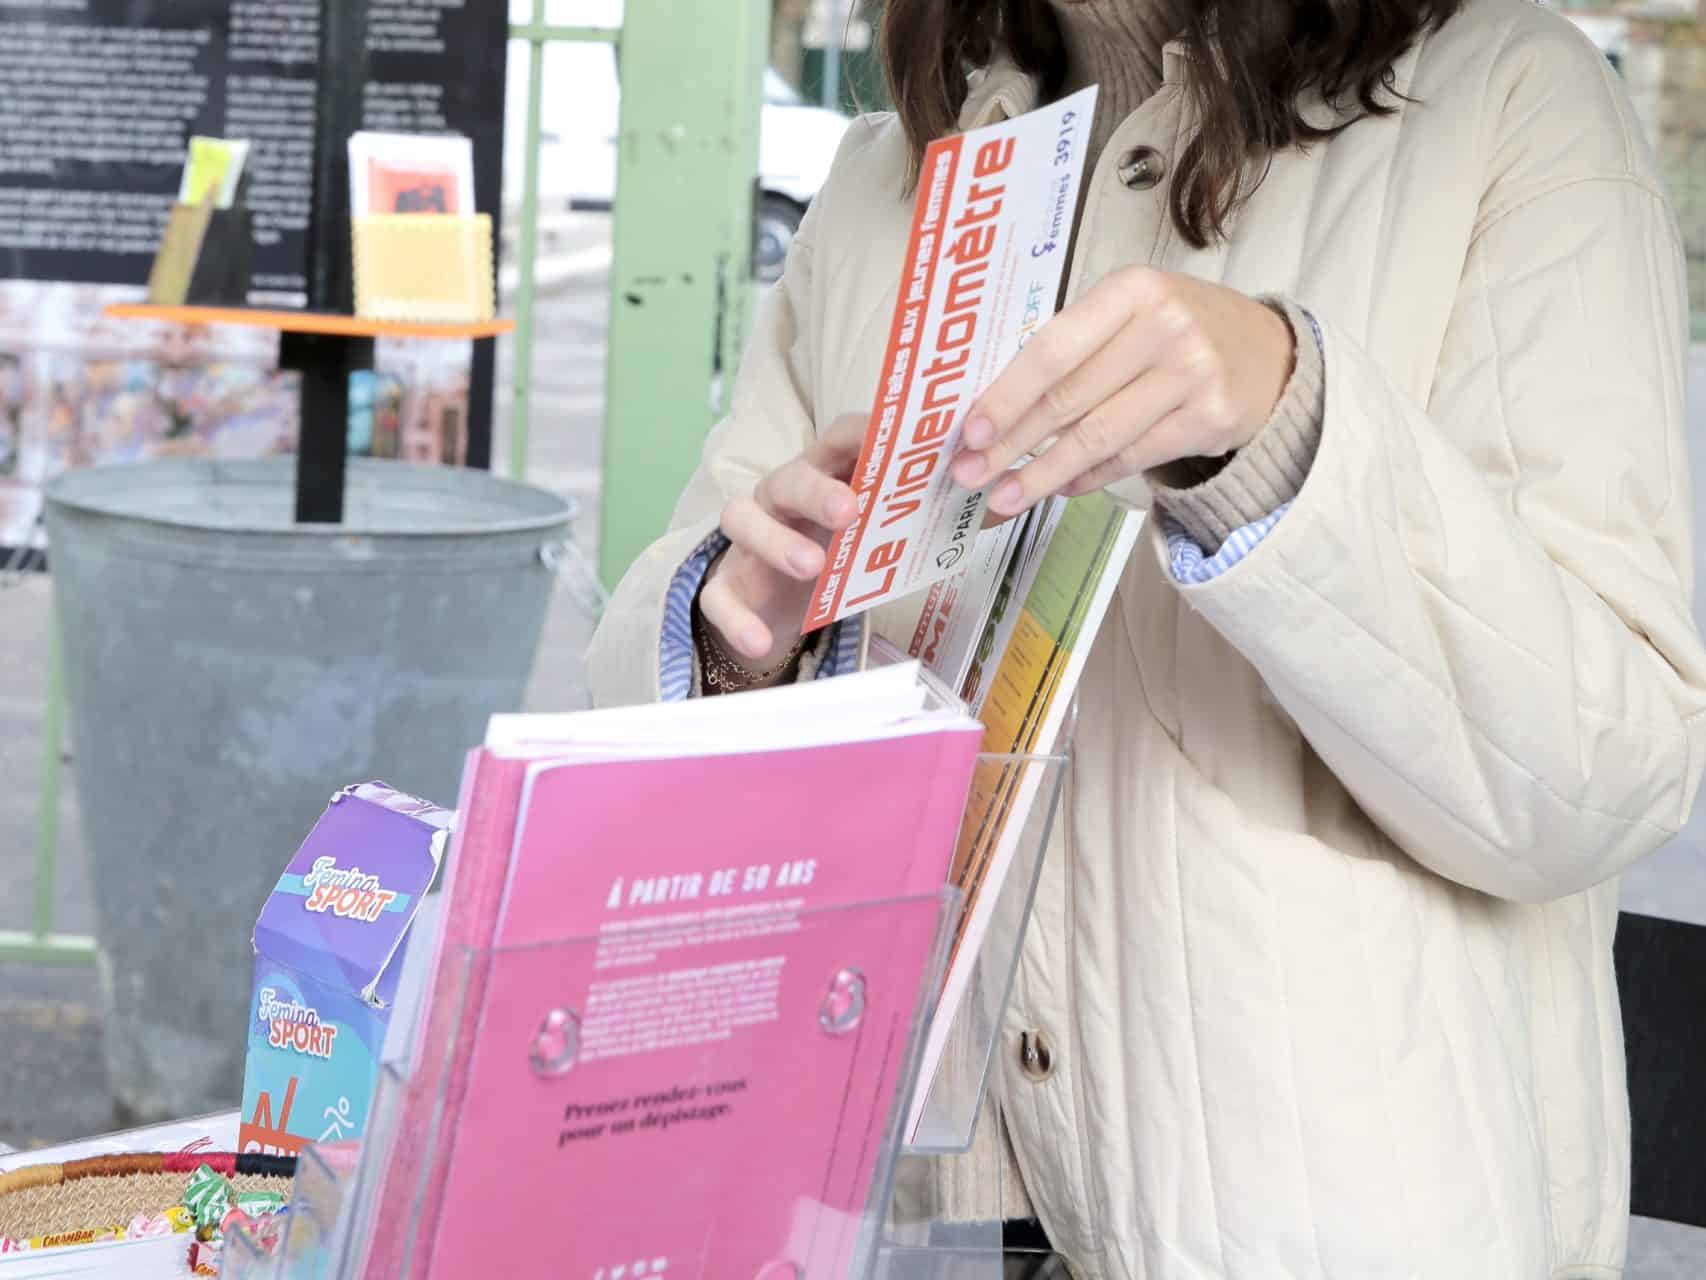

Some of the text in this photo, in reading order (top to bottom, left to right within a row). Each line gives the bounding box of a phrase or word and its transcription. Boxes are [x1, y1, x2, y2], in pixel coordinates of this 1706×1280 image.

[1053, 111, 1076, 167] 3919
[899, 306, 921, 346] aux
[846, 538, 908, 608] Le
[880, 136, 1017, 528] violentomètre
[952, 491, 982, 542] PARIS
[306, 858, 378, 892] Femina
[629, 873, 703, 906] PARTIR
[708, 868, 737, 897] DE
[741, 863, 771, 893] 50
[775, 858, 817, 888] ANS
[308, 884, 394, 920] SPORT
[259, 990, 319, 1026] Femina
[270, 1019, 336, 1055] SPORT
[564, 1098, 631, 1122] Prenez
[559, 1124, 607, 1150] pour
